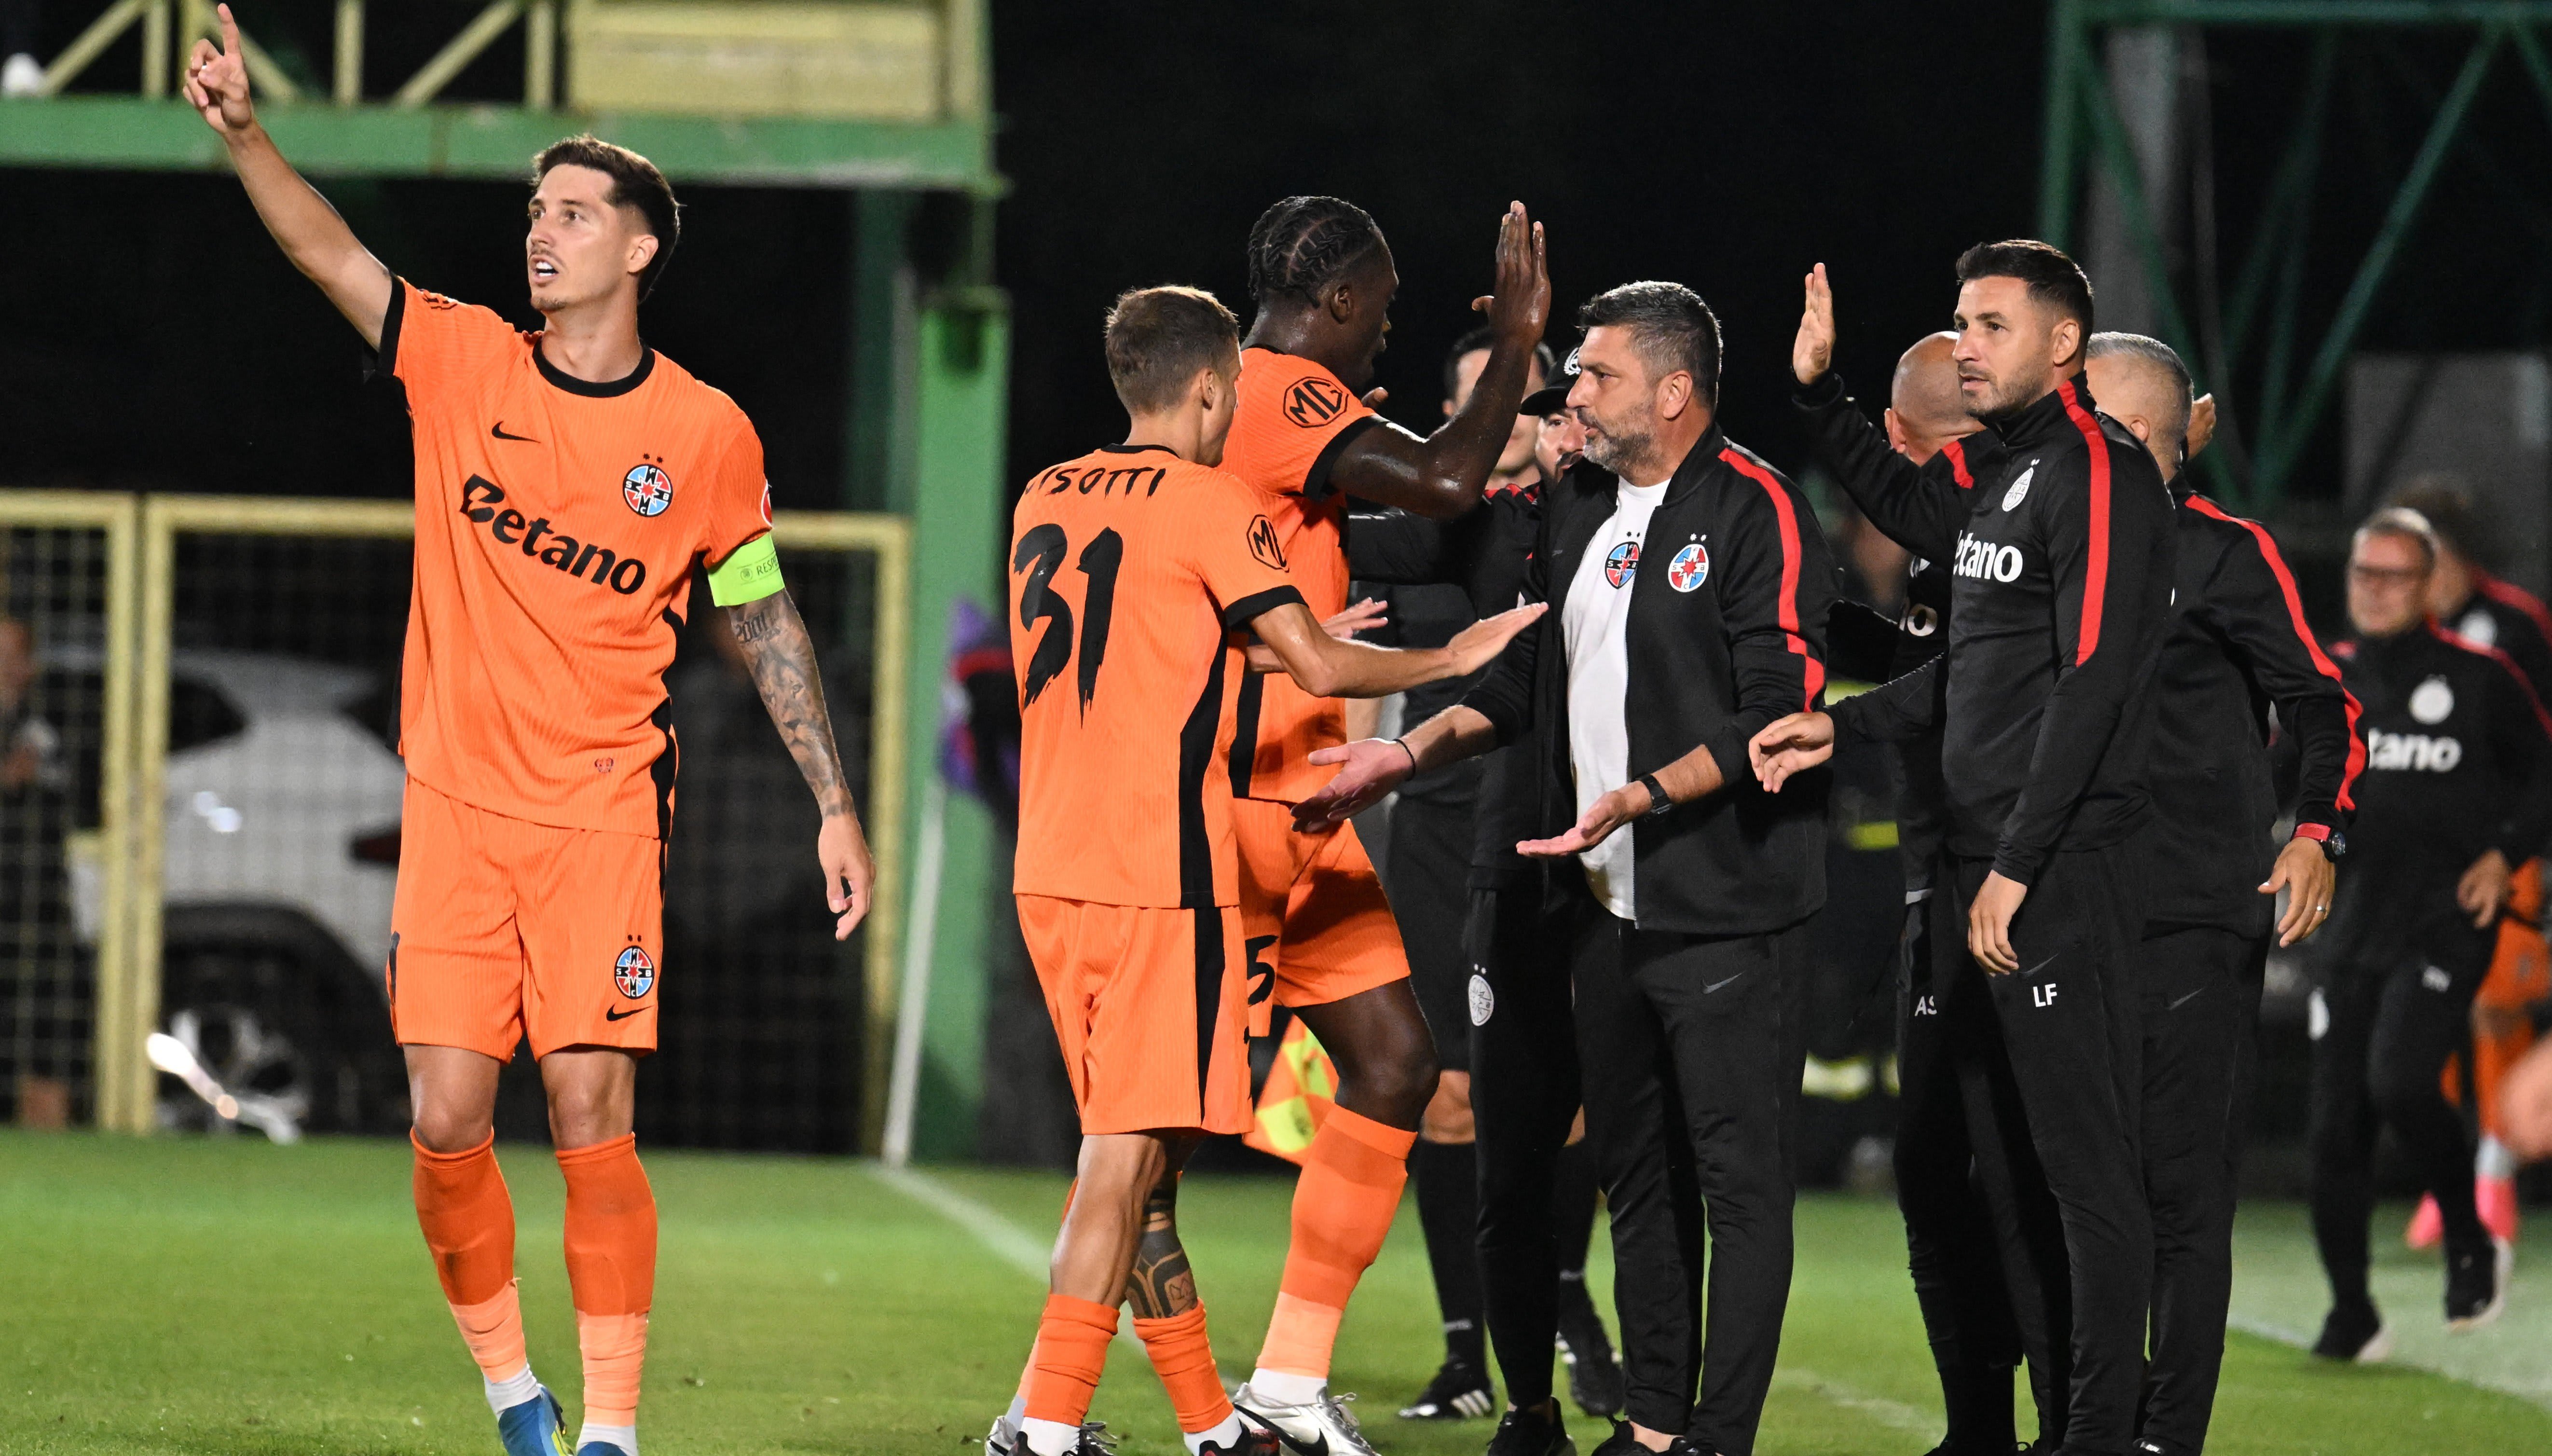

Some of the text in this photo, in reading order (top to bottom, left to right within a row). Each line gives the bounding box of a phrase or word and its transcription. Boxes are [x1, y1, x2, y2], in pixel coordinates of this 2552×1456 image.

[1289, 380, 1343, 424] MG
[1025, 466, 1166, 500] ISOTTI
[459, 473, 646, 595] Betano
[1953, 529, 2023, 583] etano
[1013, 523, 1124, 729] 31
[2033, 983, 2058, 1008] LF
